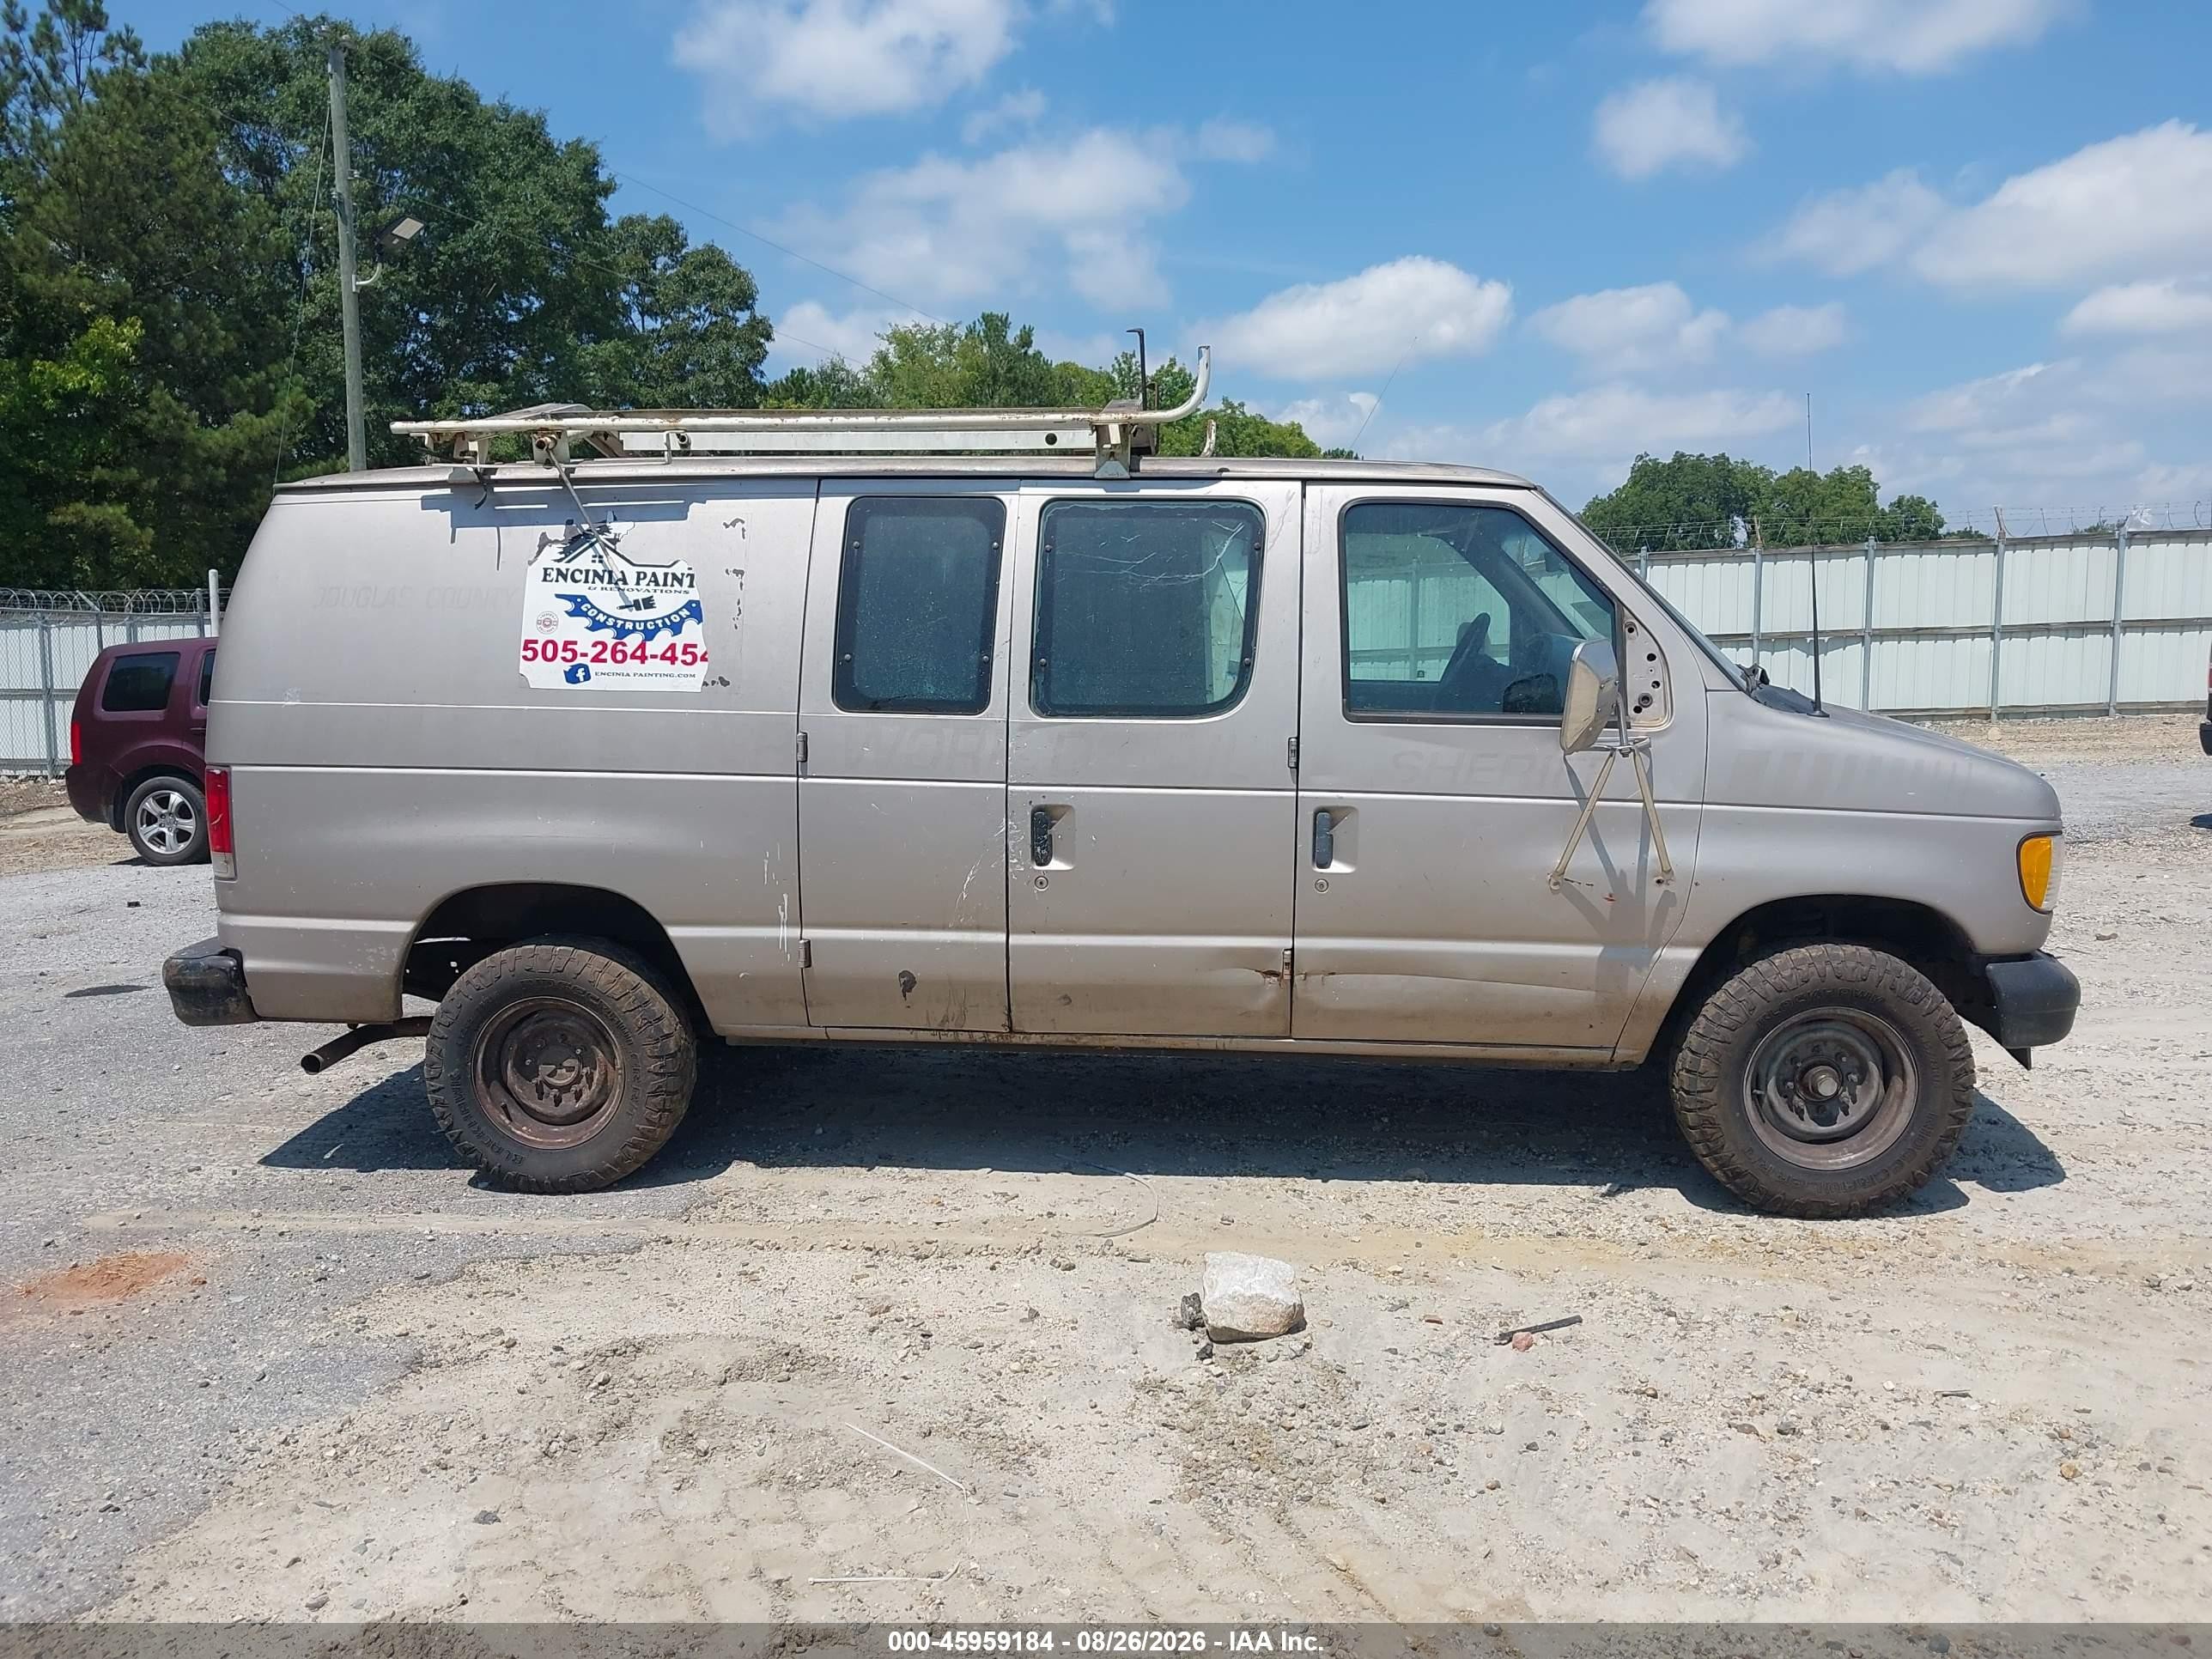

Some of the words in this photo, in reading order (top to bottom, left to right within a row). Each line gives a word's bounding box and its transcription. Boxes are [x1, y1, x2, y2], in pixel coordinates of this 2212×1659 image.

[541, 567, 629, 586] ENCINIA
[600, 586, 690, 595] RENOVATIONS
[580, 603, 692, 631] CONSTRUCTION
